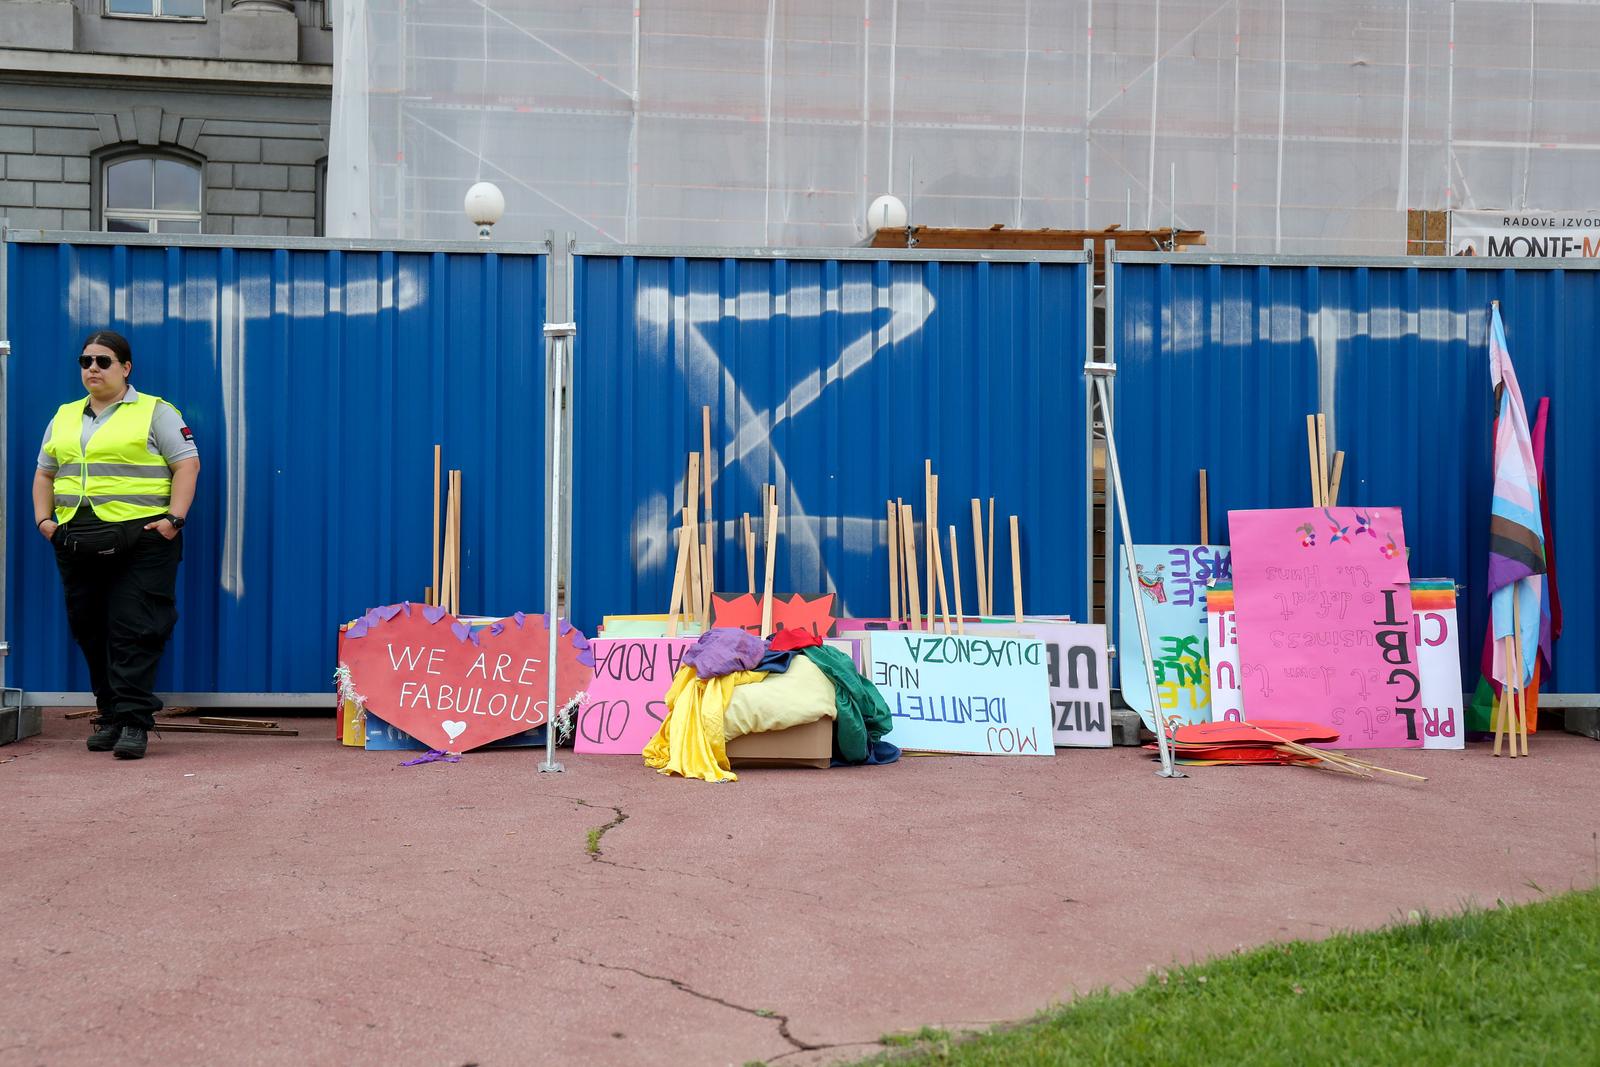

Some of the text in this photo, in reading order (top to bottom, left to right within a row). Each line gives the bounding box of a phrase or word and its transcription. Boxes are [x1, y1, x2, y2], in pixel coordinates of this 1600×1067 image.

[1503, 217, 1556, 227] RADOVE
[1274, 591, 1353, 621] defeat
[594, 642, 656, 682] RODA
[904, 636, 1042, 667] DIJAGNOZA
[1269, 630, 1412, 665] Business
[387, 643, 541, 685] WE ARE
[875, 661, 919, 689] NIJE
[399, 682, 548, 724] FABULOUS
[891, 691, 1008, 724] IDENTITET
[1050, 701, 1105, 732] MIZ
[580, 700, 630, 744] OD
[1422, 707, 1456, 738] PR
[987, 727, 1038, 753] MOJ
